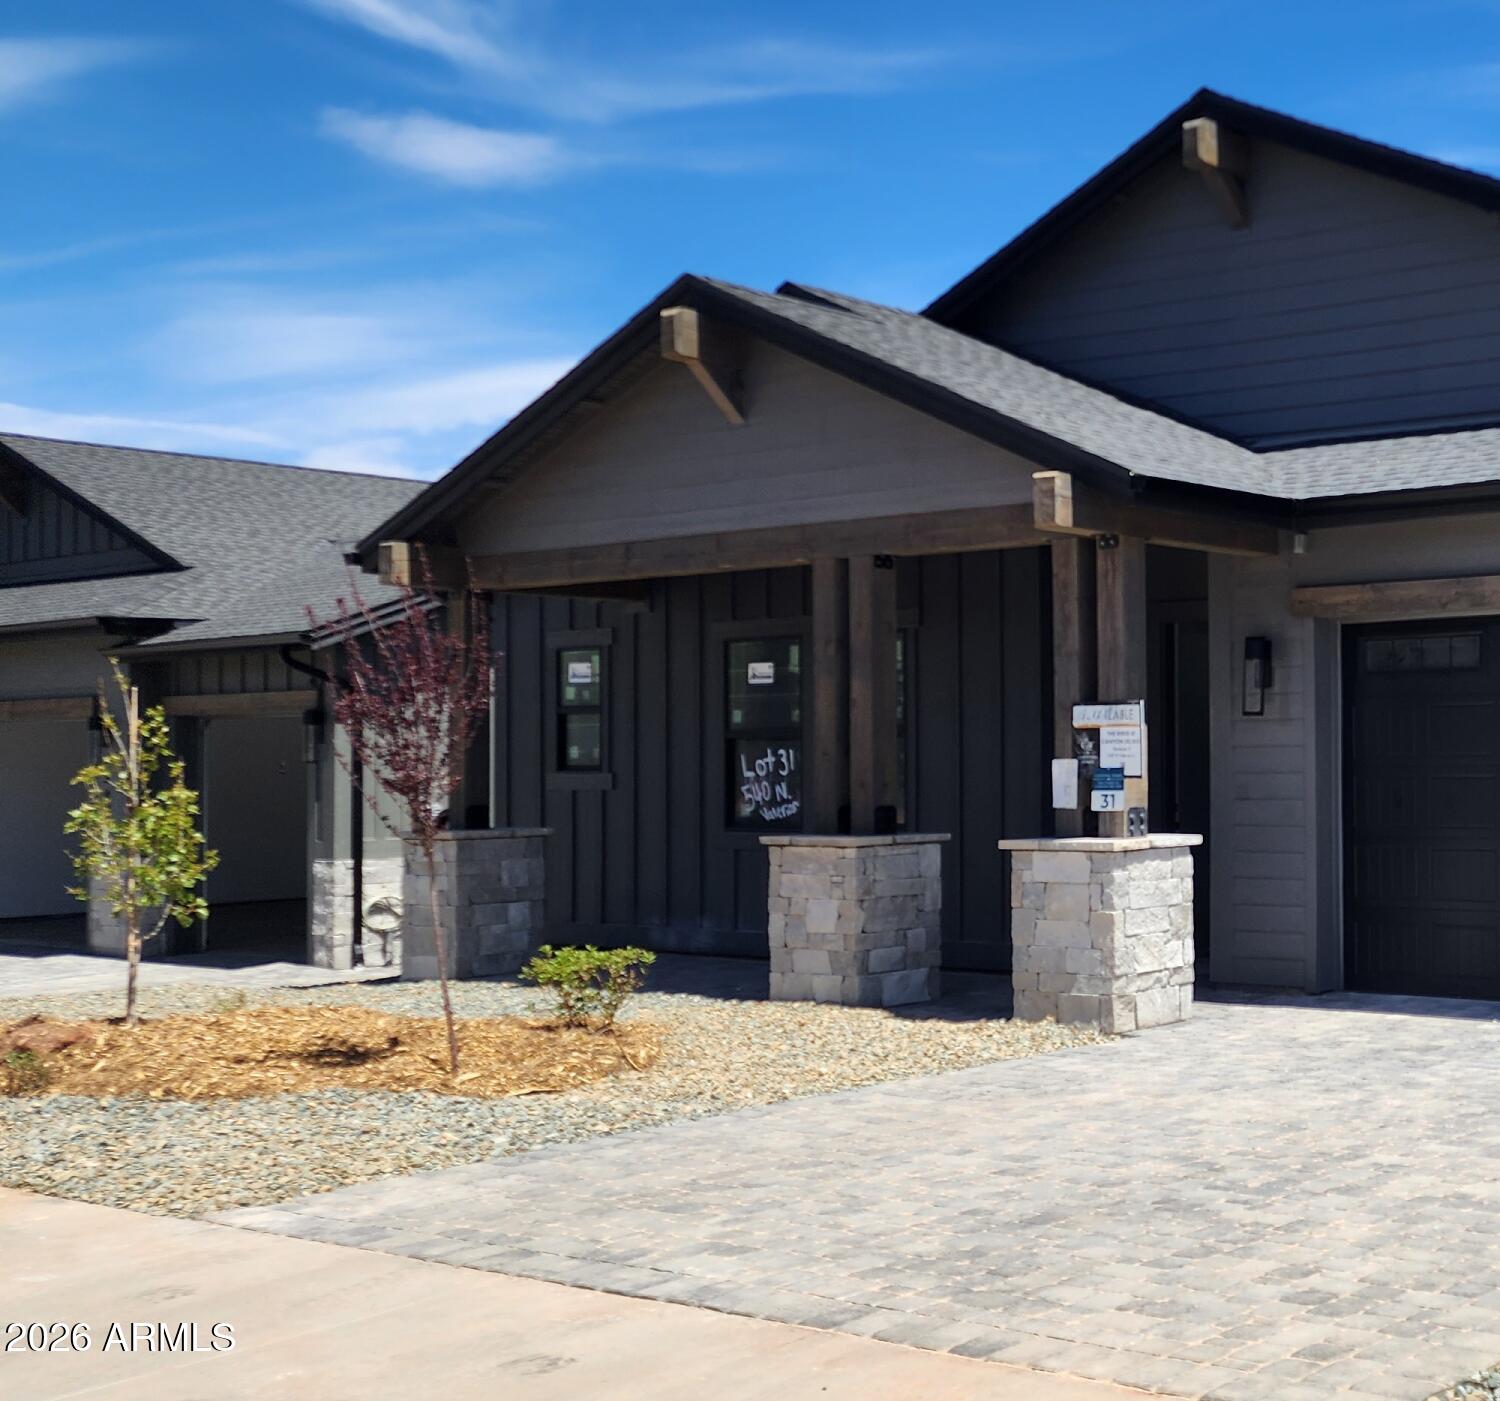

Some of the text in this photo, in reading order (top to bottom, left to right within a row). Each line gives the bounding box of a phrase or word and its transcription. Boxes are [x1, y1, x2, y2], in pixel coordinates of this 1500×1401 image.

[1080, 708, 1134, 721] ILABLE
[741, 747, 795, 777] Lot 31
[740, 781, 792, 812] 540 N.
[1100, 793, 1116, 809] 31
